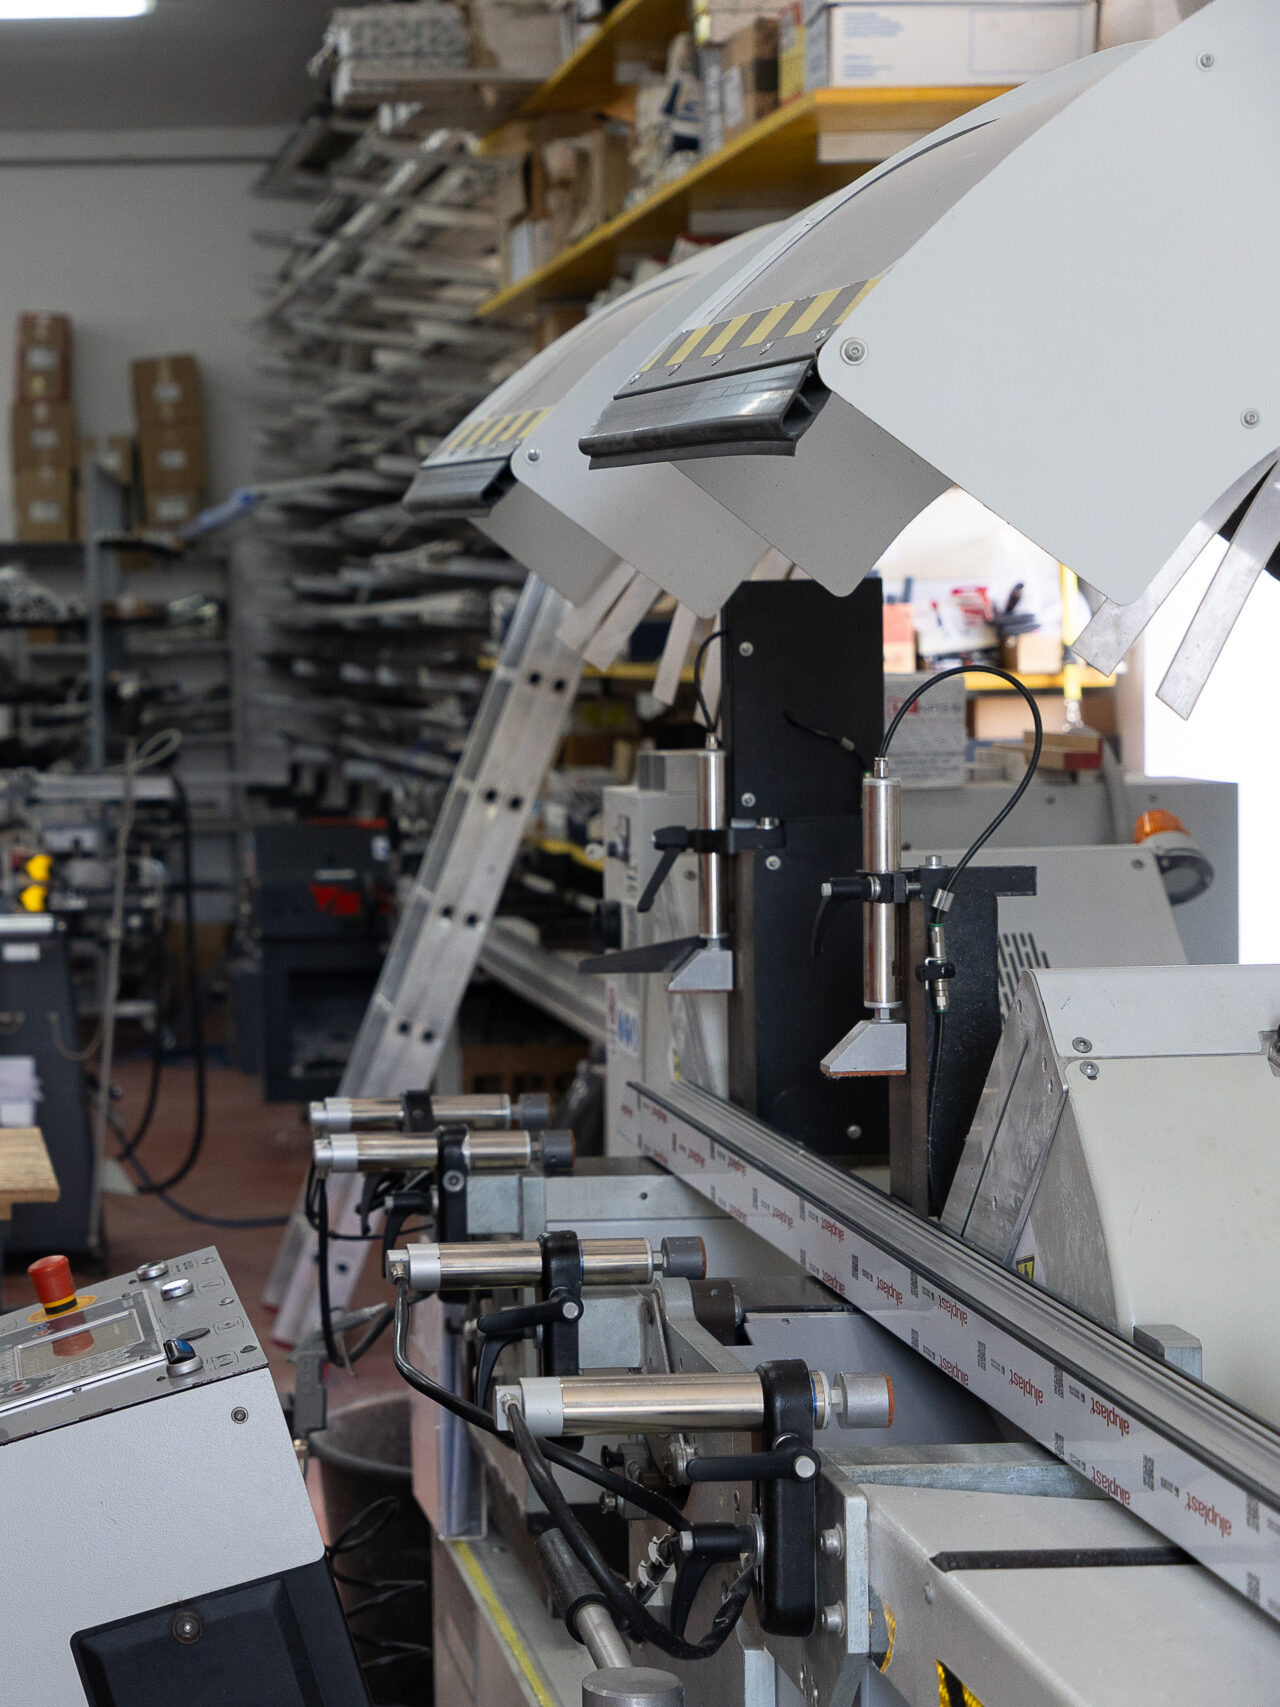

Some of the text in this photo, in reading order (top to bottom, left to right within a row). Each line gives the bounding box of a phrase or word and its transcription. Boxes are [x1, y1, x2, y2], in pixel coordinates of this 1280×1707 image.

[876, 1276, 903, 1306] aluplast
[938, 1295, 968, 1326] aluplast
[939, 1355, 970, 1386] aluplast
[1009, 1369, 1044, 1405] aluplast
[1090, 1397, 1130, 1437] aluplast
[1091, 1466, 1131, 1506] aluplast
[1185, 1491, 1232, 1538] aluplast
